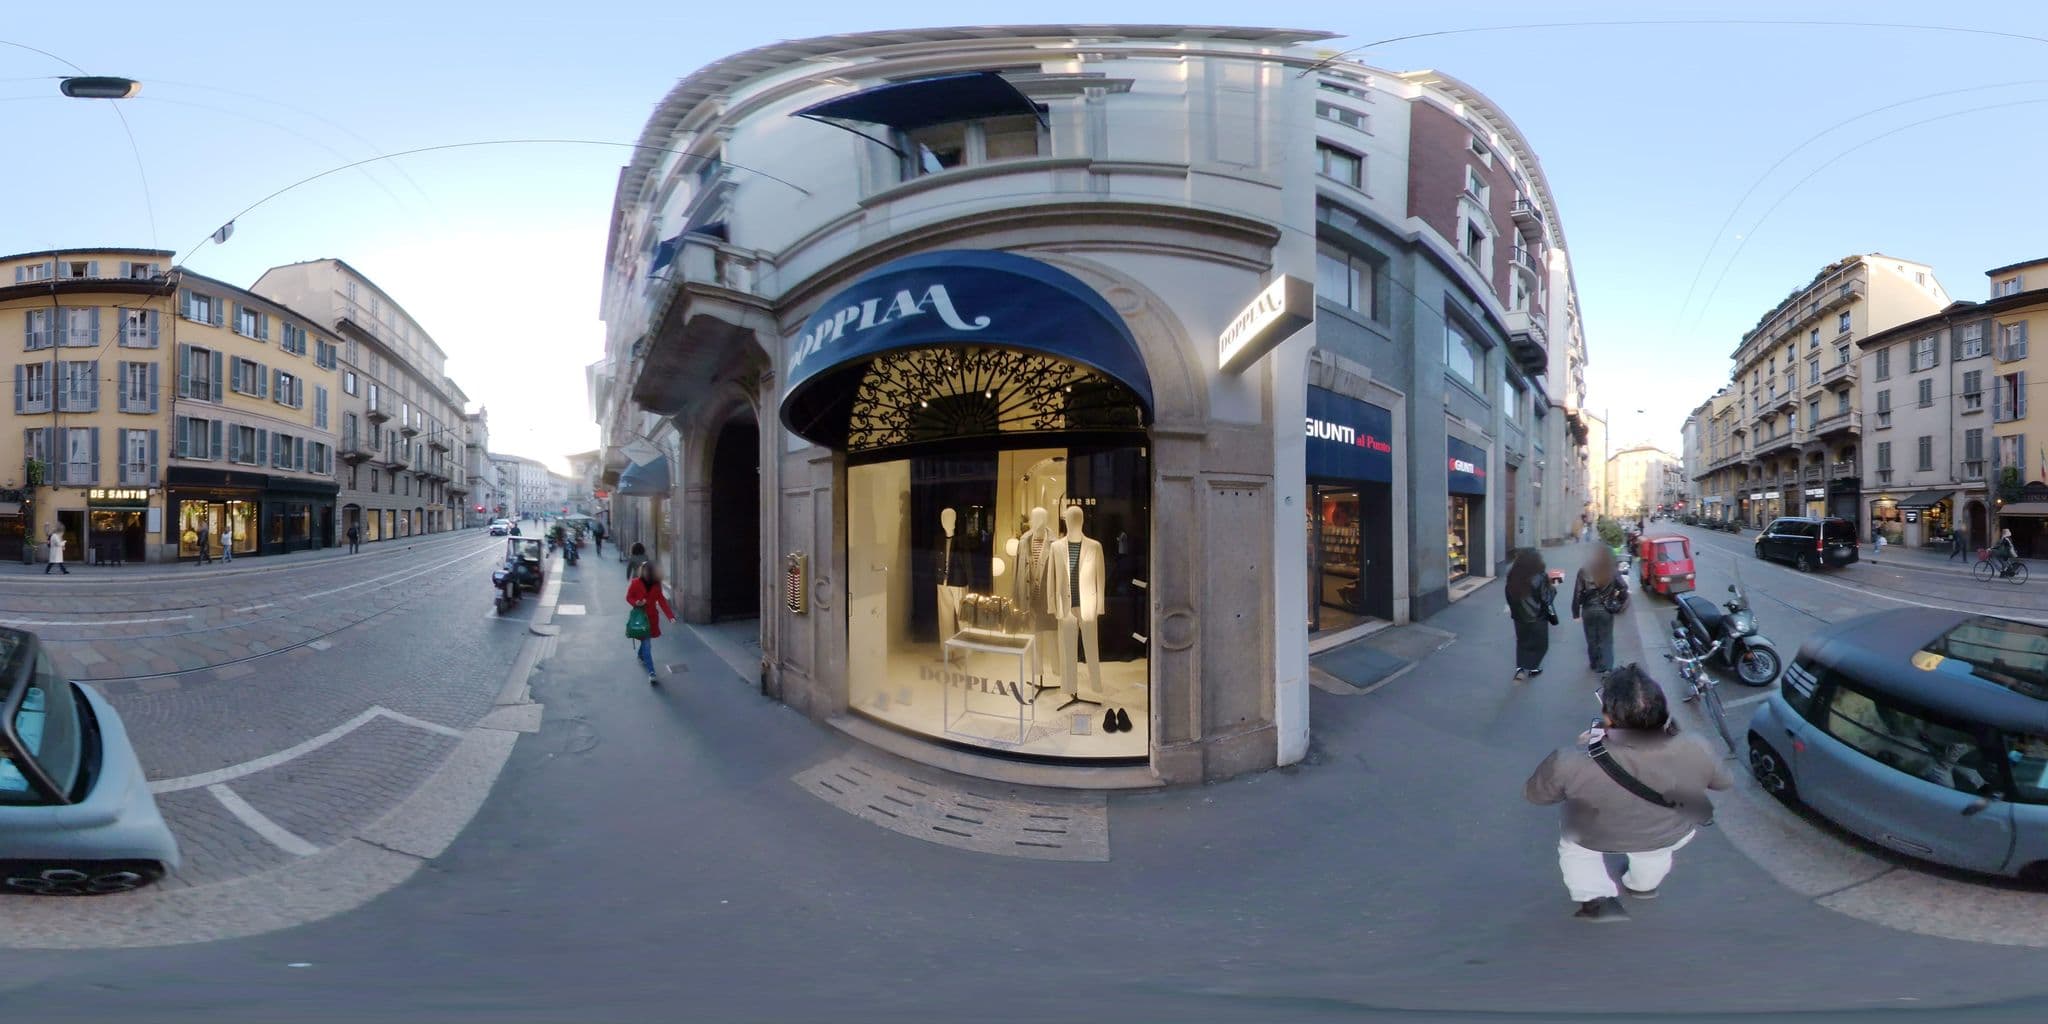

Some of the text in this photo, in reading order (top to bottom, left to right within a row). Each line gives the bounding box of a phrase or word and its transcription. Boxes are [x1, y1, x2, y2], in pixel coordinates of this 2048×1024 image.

[1305, 417, 1355, 445] GIUNTI
[90, 489, 105, 499] DE
[920, 665, 1034, 706] DOPPIAA
